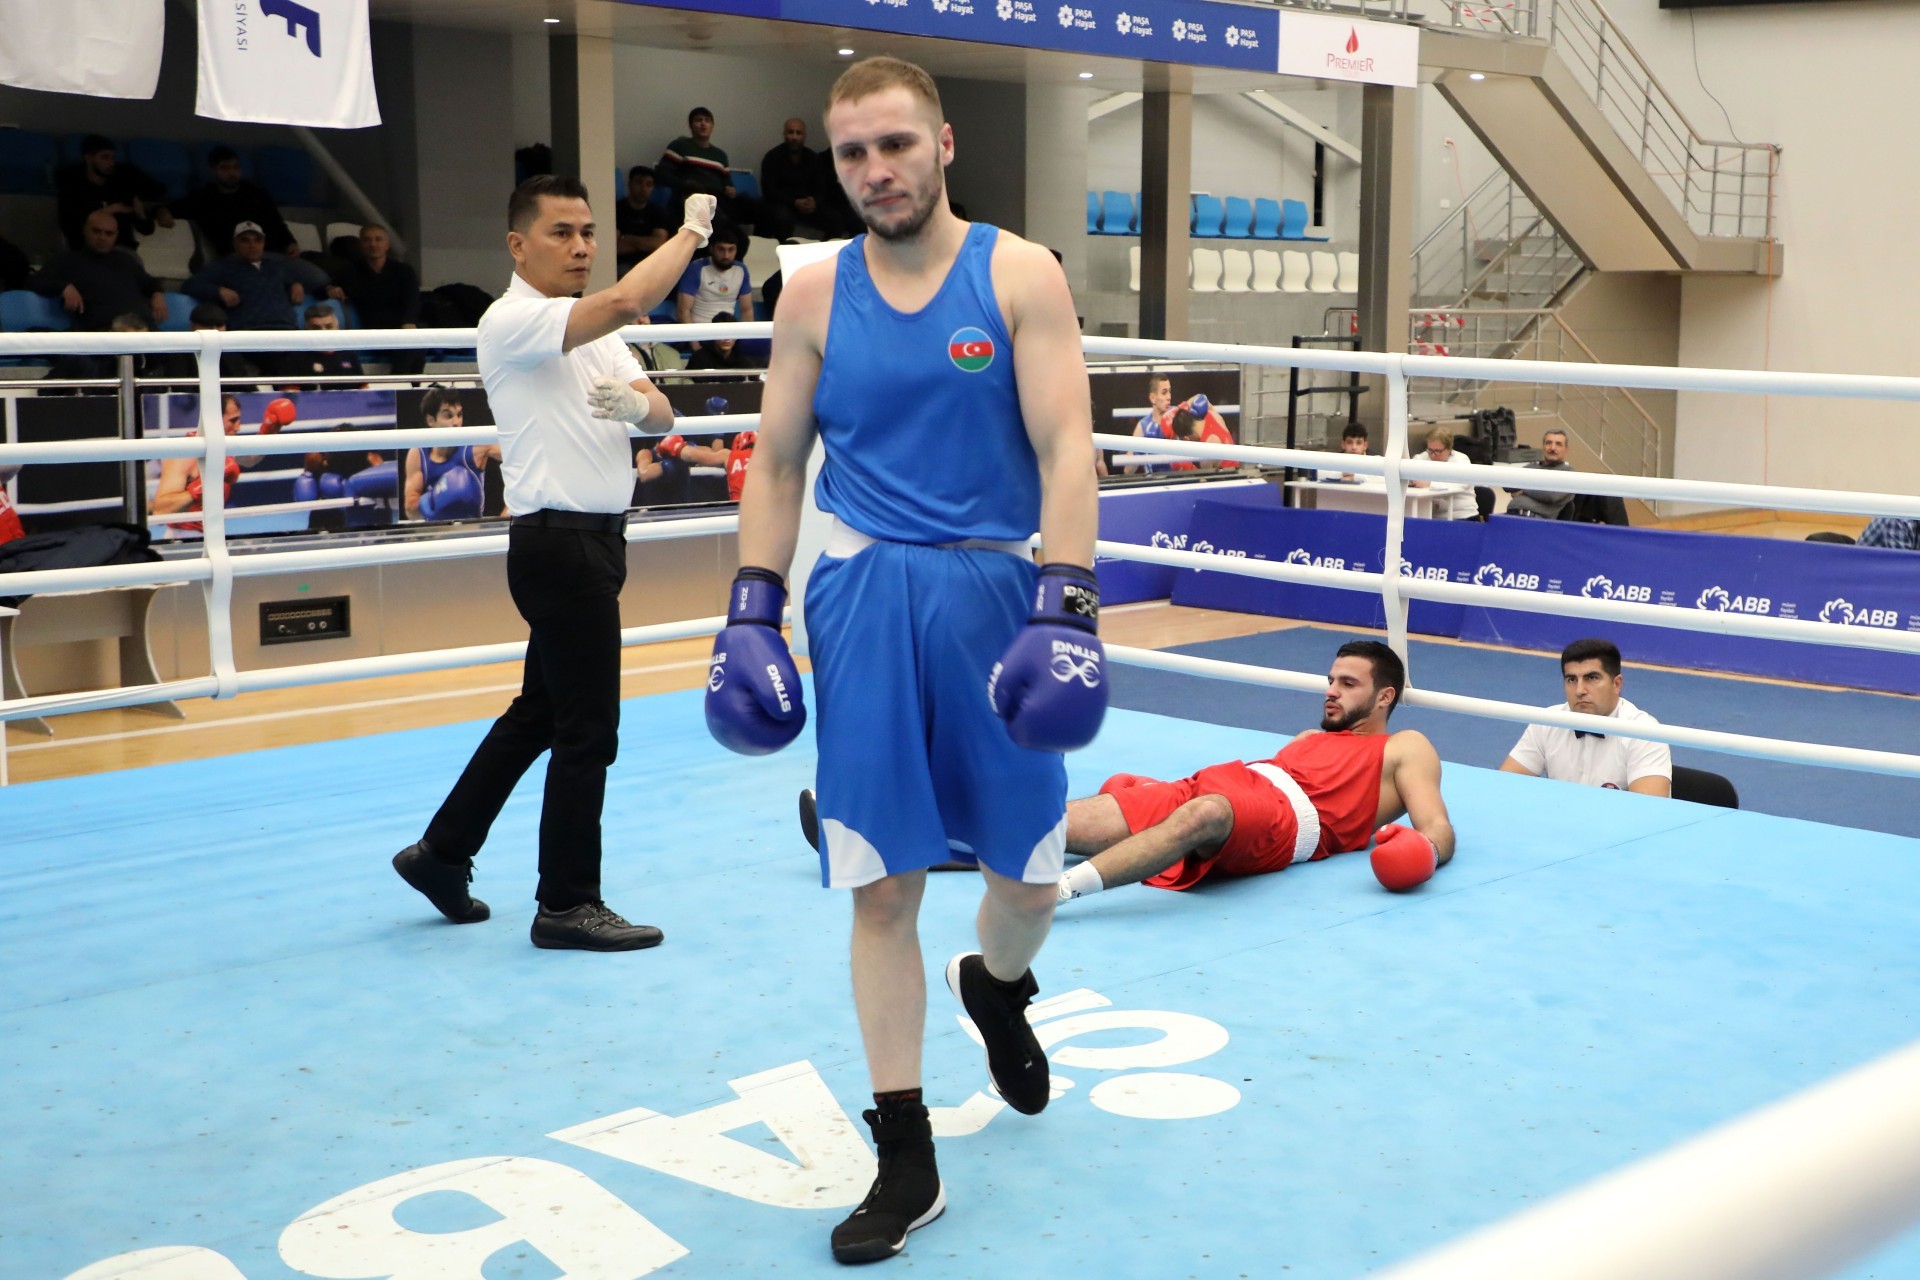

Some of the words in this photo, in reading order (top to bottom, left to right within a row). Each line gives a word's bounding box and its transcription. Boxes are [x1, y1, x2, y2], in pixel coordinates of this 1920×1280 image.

[951, 3, 974, 16] Hayat
[1014, 0, 1033, 12] PAŞA
[1014, 11, 1037, 24] Hayat
[1075, 8, 1093, 20] PAŞA
[235, 0, 248, 51] SİYASI
[1075, 19, 1096, 31] Hayat
[1132, 15, 1150, 27] PAŞA
[1187, 22, 1204, 33] PAŞA
[1132, 26, 1153, 37] Hayat
[1187, 32, 1208, 43] Hayat
[1240, 28, 1257, 39] PAŞA
[1240, 38, 1260, 49] Hayat
[1312, 556, 1345, 571] ABB
[1413, 566, 1449, 582] ABB
[1502, 572, 1540, 590] ABB
[1613, 584, 1652, 602] ABB
[1729, 595, 1771, 614] ABB
[1854, 608, 1898, 628] ABB
[1052, 639, 1100, 663] STING
[766, 663, 792, 713] STING
[61, 1059, 879, 1280] AB
